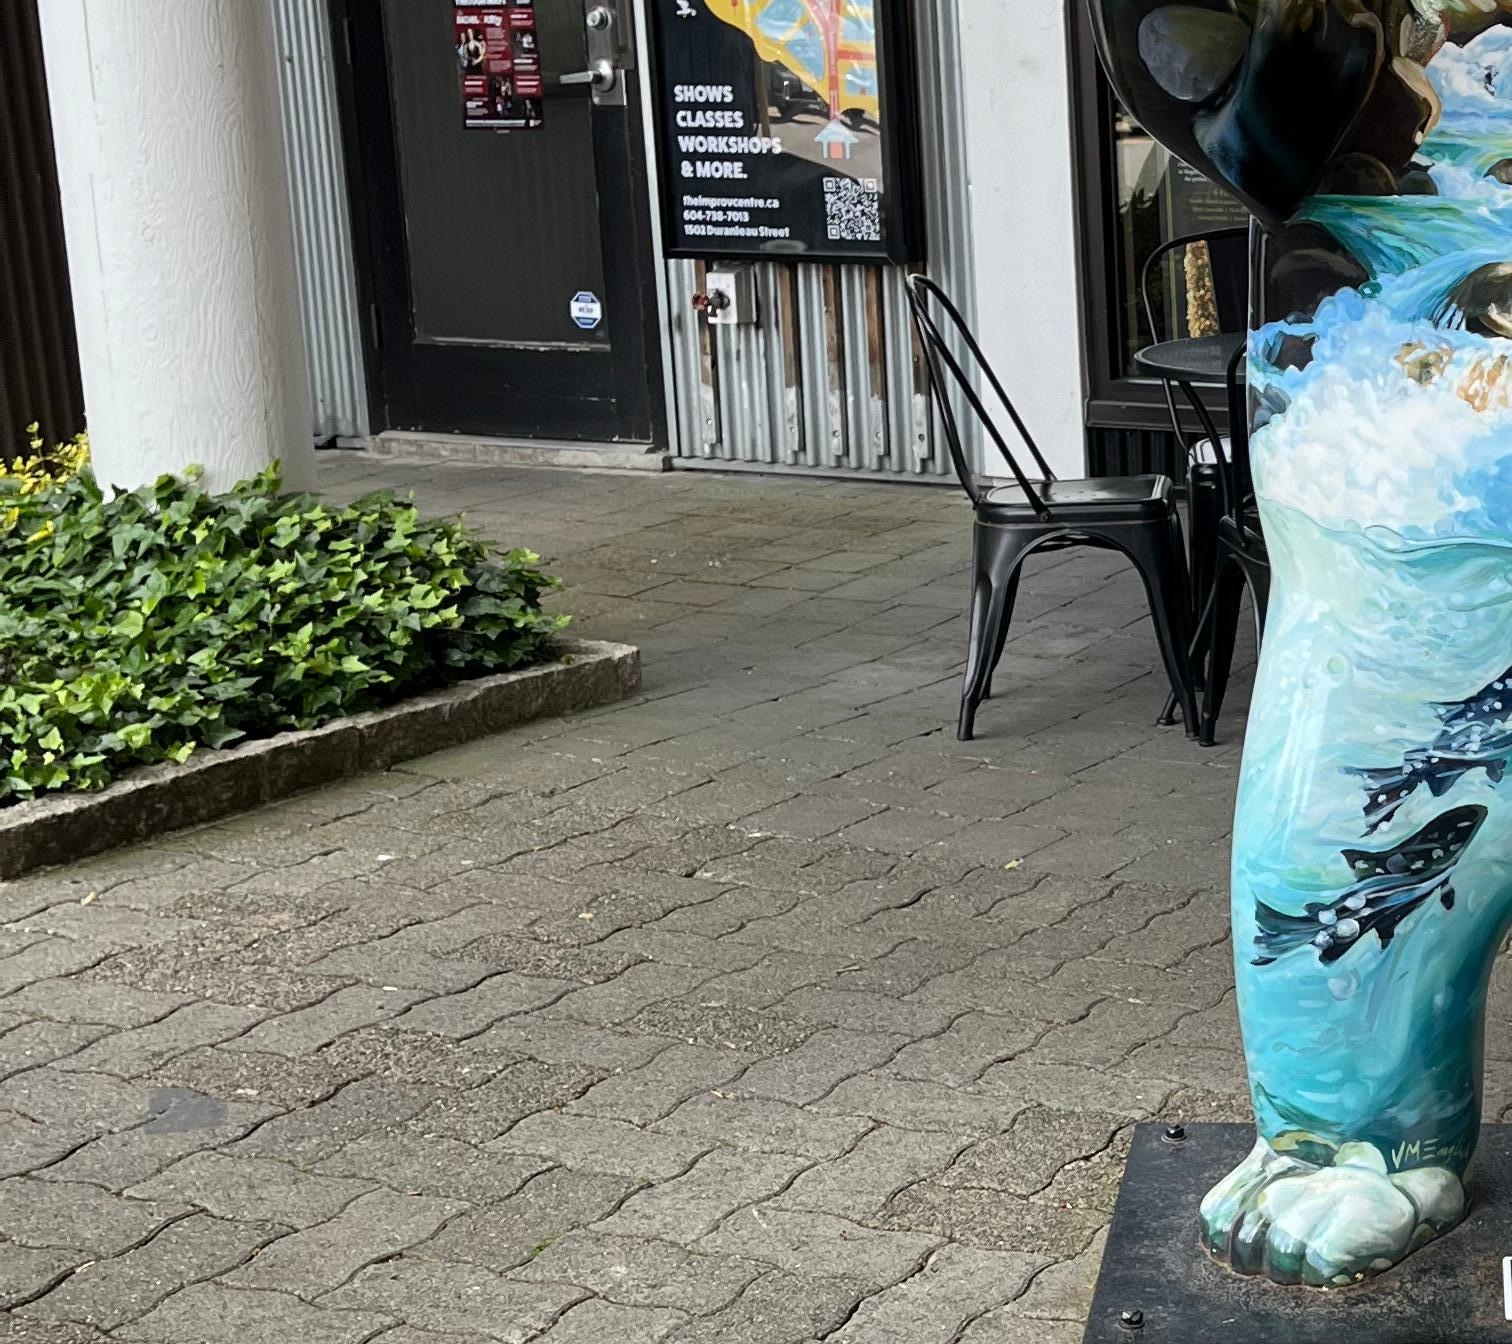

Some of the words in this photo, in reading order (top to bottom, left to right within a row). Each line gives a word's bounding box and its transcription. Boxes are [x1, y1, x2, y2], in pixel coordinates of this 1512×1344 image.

[674, 85, 734, 103] SHOWS
[676, 110, 745, 129] CLASSES
[677, 136, 783, 155] WORKSHOPS
[680, 160, 694, 178] &
[695, 160, 749, 179] MORE.
[759, 225, 790, 238] Street
